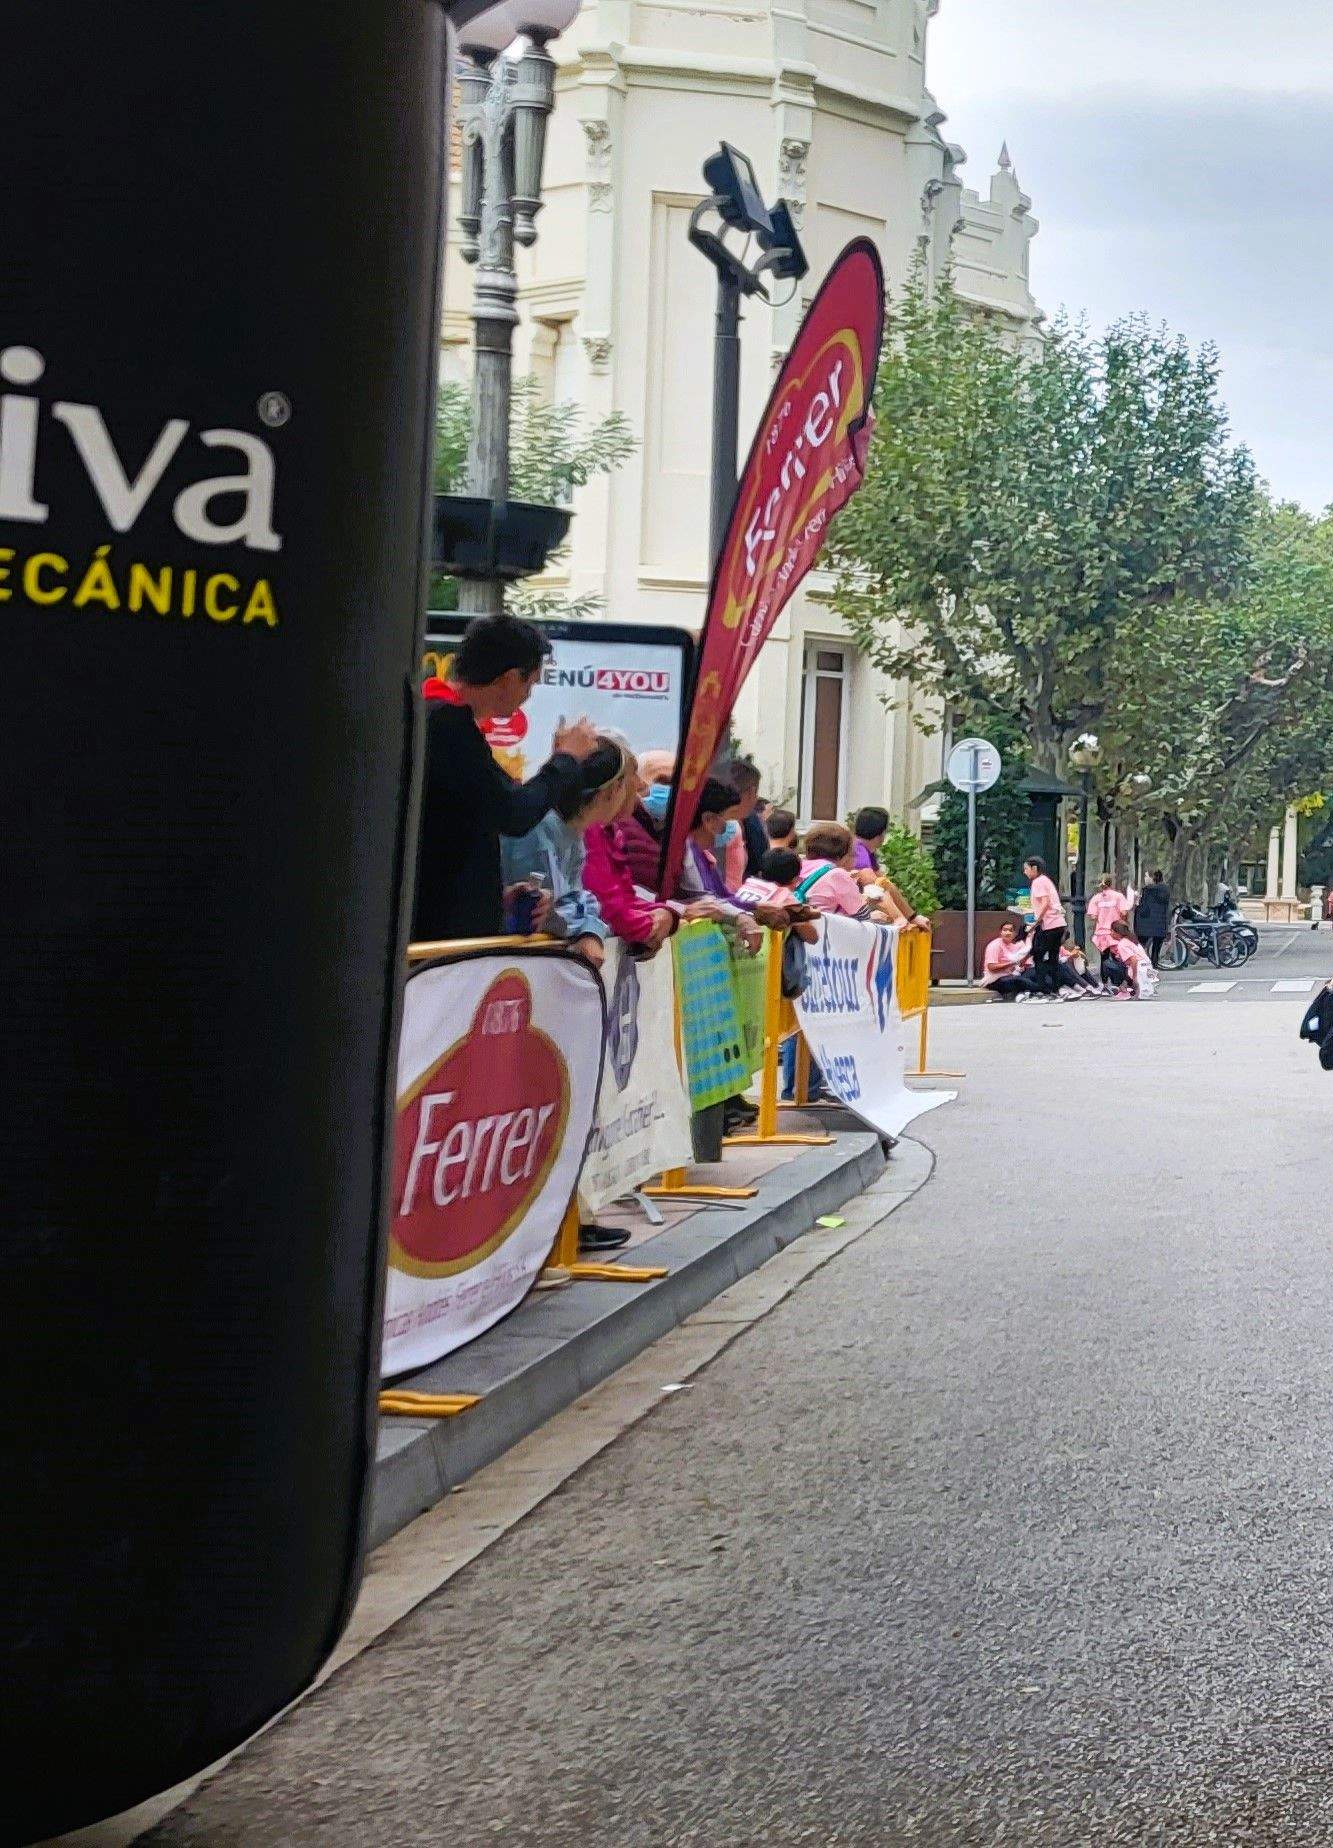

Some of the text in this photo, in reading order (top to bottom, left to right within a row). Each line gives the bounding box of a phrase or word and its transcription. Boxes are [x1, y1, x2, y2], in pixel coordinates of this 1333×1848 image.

[542, 665, 668, 691] ENÚ 4YOU
[400, 1092, 556, 1216] Ferrer
